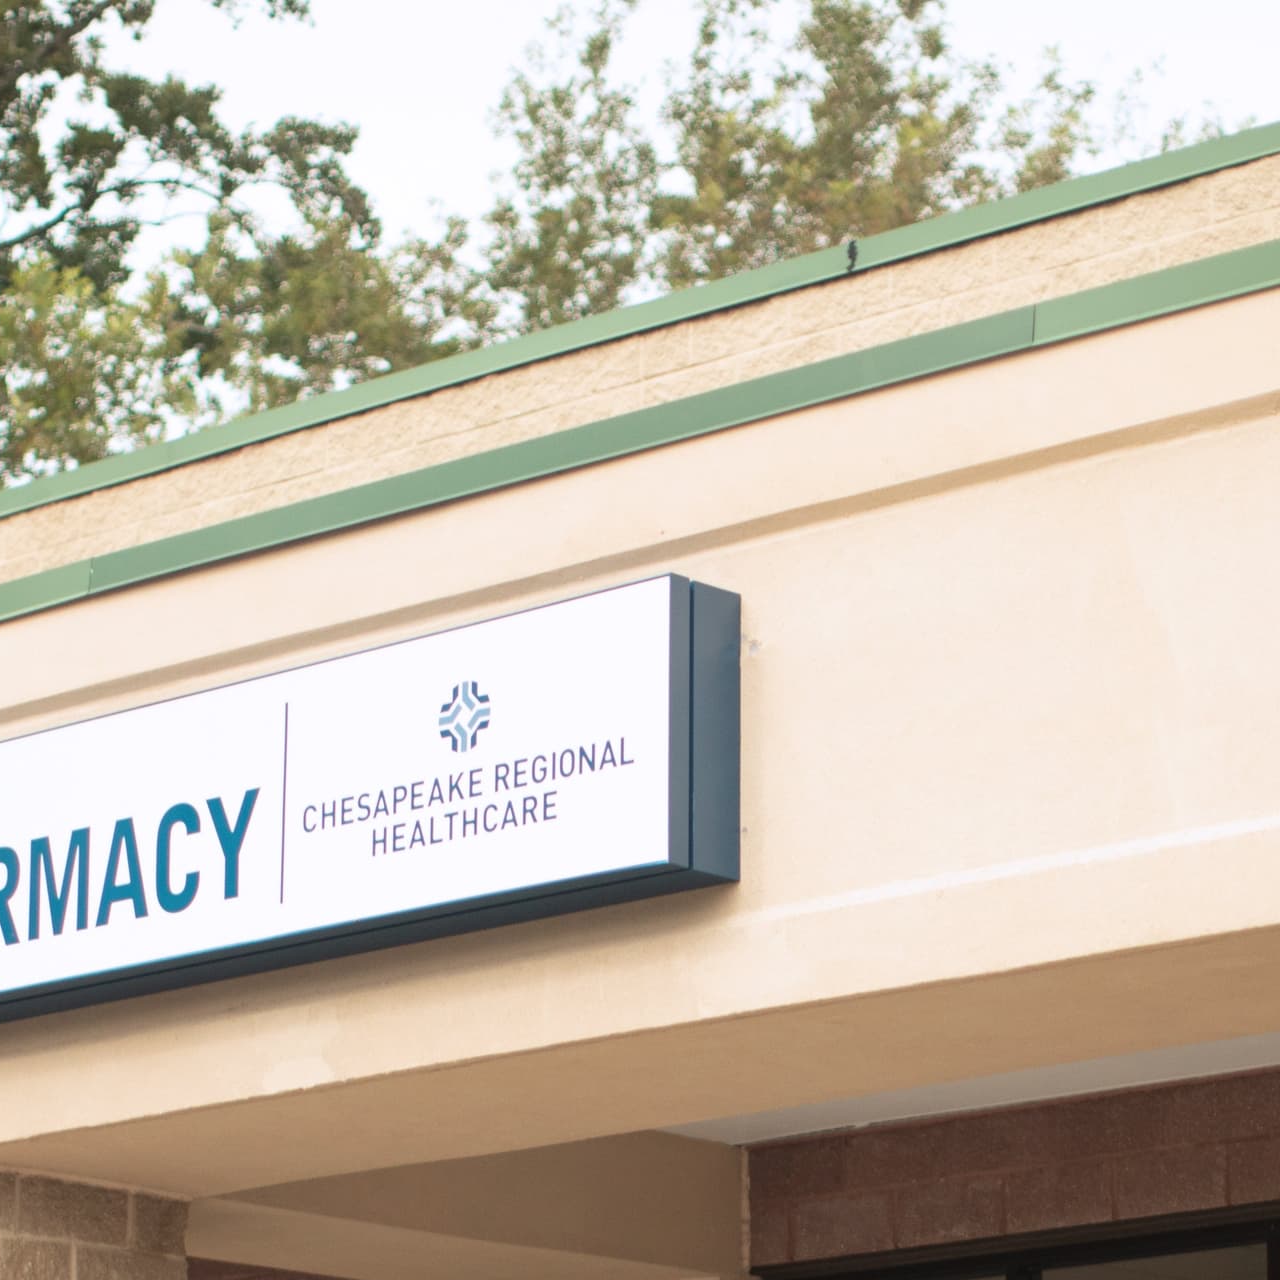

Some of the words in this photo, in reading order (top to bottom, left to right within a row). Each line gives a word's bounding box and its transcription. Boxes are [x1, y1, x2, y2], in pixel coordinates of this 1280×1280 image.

[303, 768, 484, 832] CHESAPEAKE
[494, 737, 635, 792] REGIONAL
[372, 791, 558, 857] HEALTHCARE
